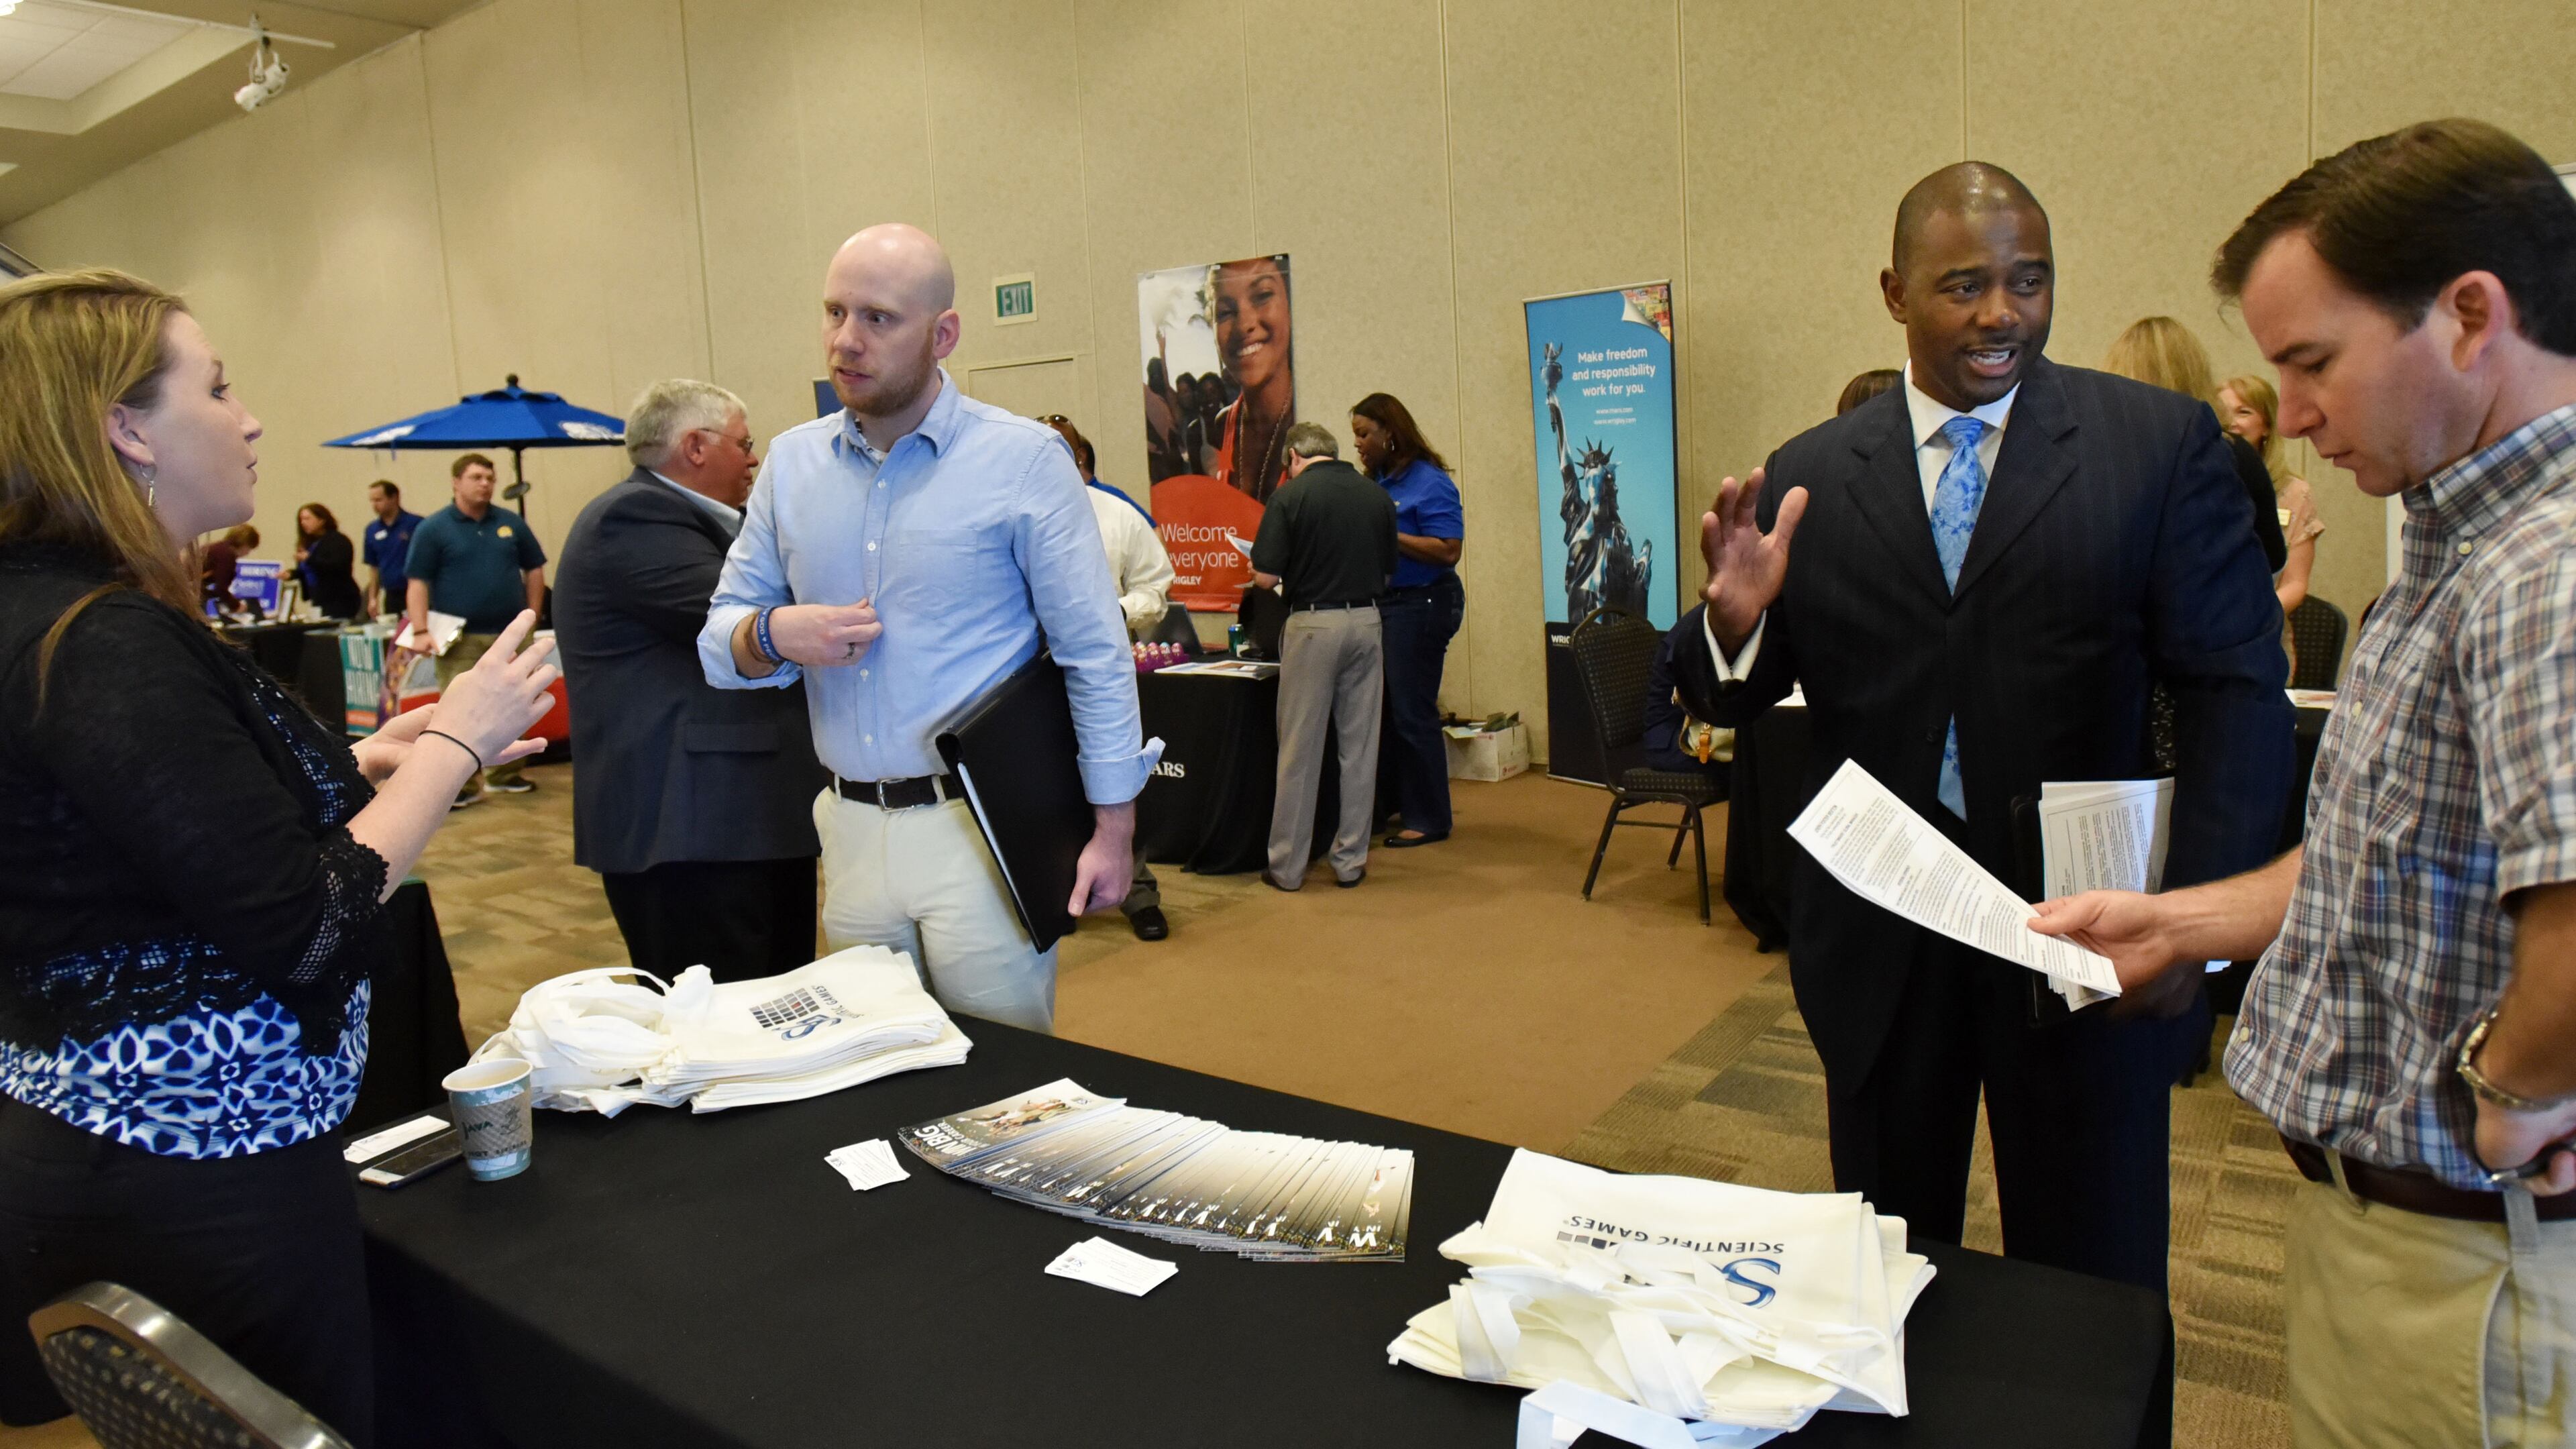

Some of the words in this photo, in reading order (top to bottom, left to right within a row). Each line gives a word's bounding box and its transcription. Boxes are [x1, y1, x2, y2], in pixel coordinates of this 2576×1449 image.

[1000, 284, 1029, 316] EXIT
[1578, 351, 1604, 364] Make
[1606, 347, 1648, 361] freedom
[1572, 368, 1589, 381] and
[1592, 364, 1656, 380] responsibility
[1583, 384, 1607, 396] work
[1609, 383, 1623, 394] for
[1626, 383, 1646, 396] you.
[1161, 523, 1237, 543] Welcome
[1170, 552, 1238, 571] veryone
[1173, 576, 1201, 585] RIGLEY
[1150, 761, 1185, 778] ARS
[914, 1124, 953, 1147] BIG
[935, 1140, 977, 1157] WIN
[1570, 1216, 1649, 1242] GAMES
[1656, 1235, 1785, 1254] SCIENTIFIC
